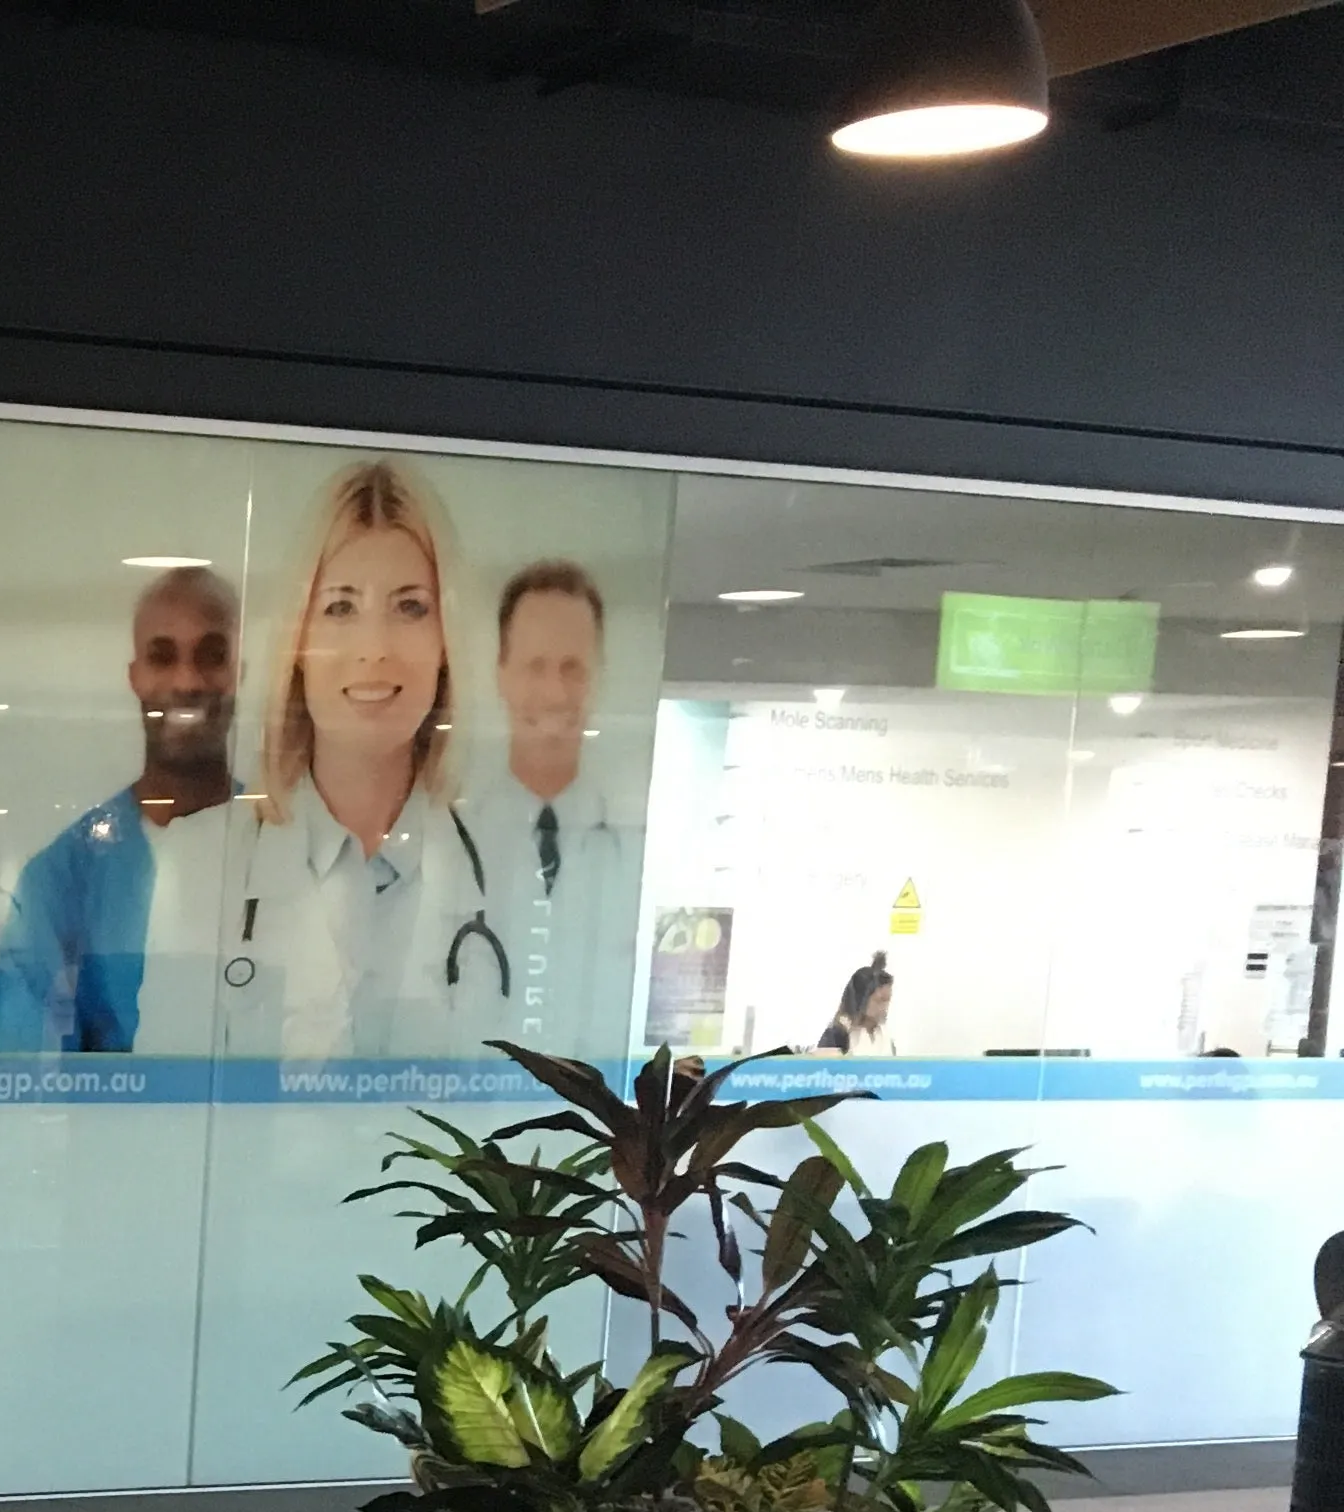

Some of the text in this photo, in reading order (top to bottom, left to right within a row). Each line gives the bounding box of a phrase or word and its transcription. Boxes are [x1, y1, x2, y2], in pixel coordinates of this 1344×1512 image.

[770, 709, 889, 737] Mole Scanning
[889, 766, 941, 786] Health
[942, 768, 1010, 789] Services
[730, 1068, 933, 1093] www.perthgp.com.au
